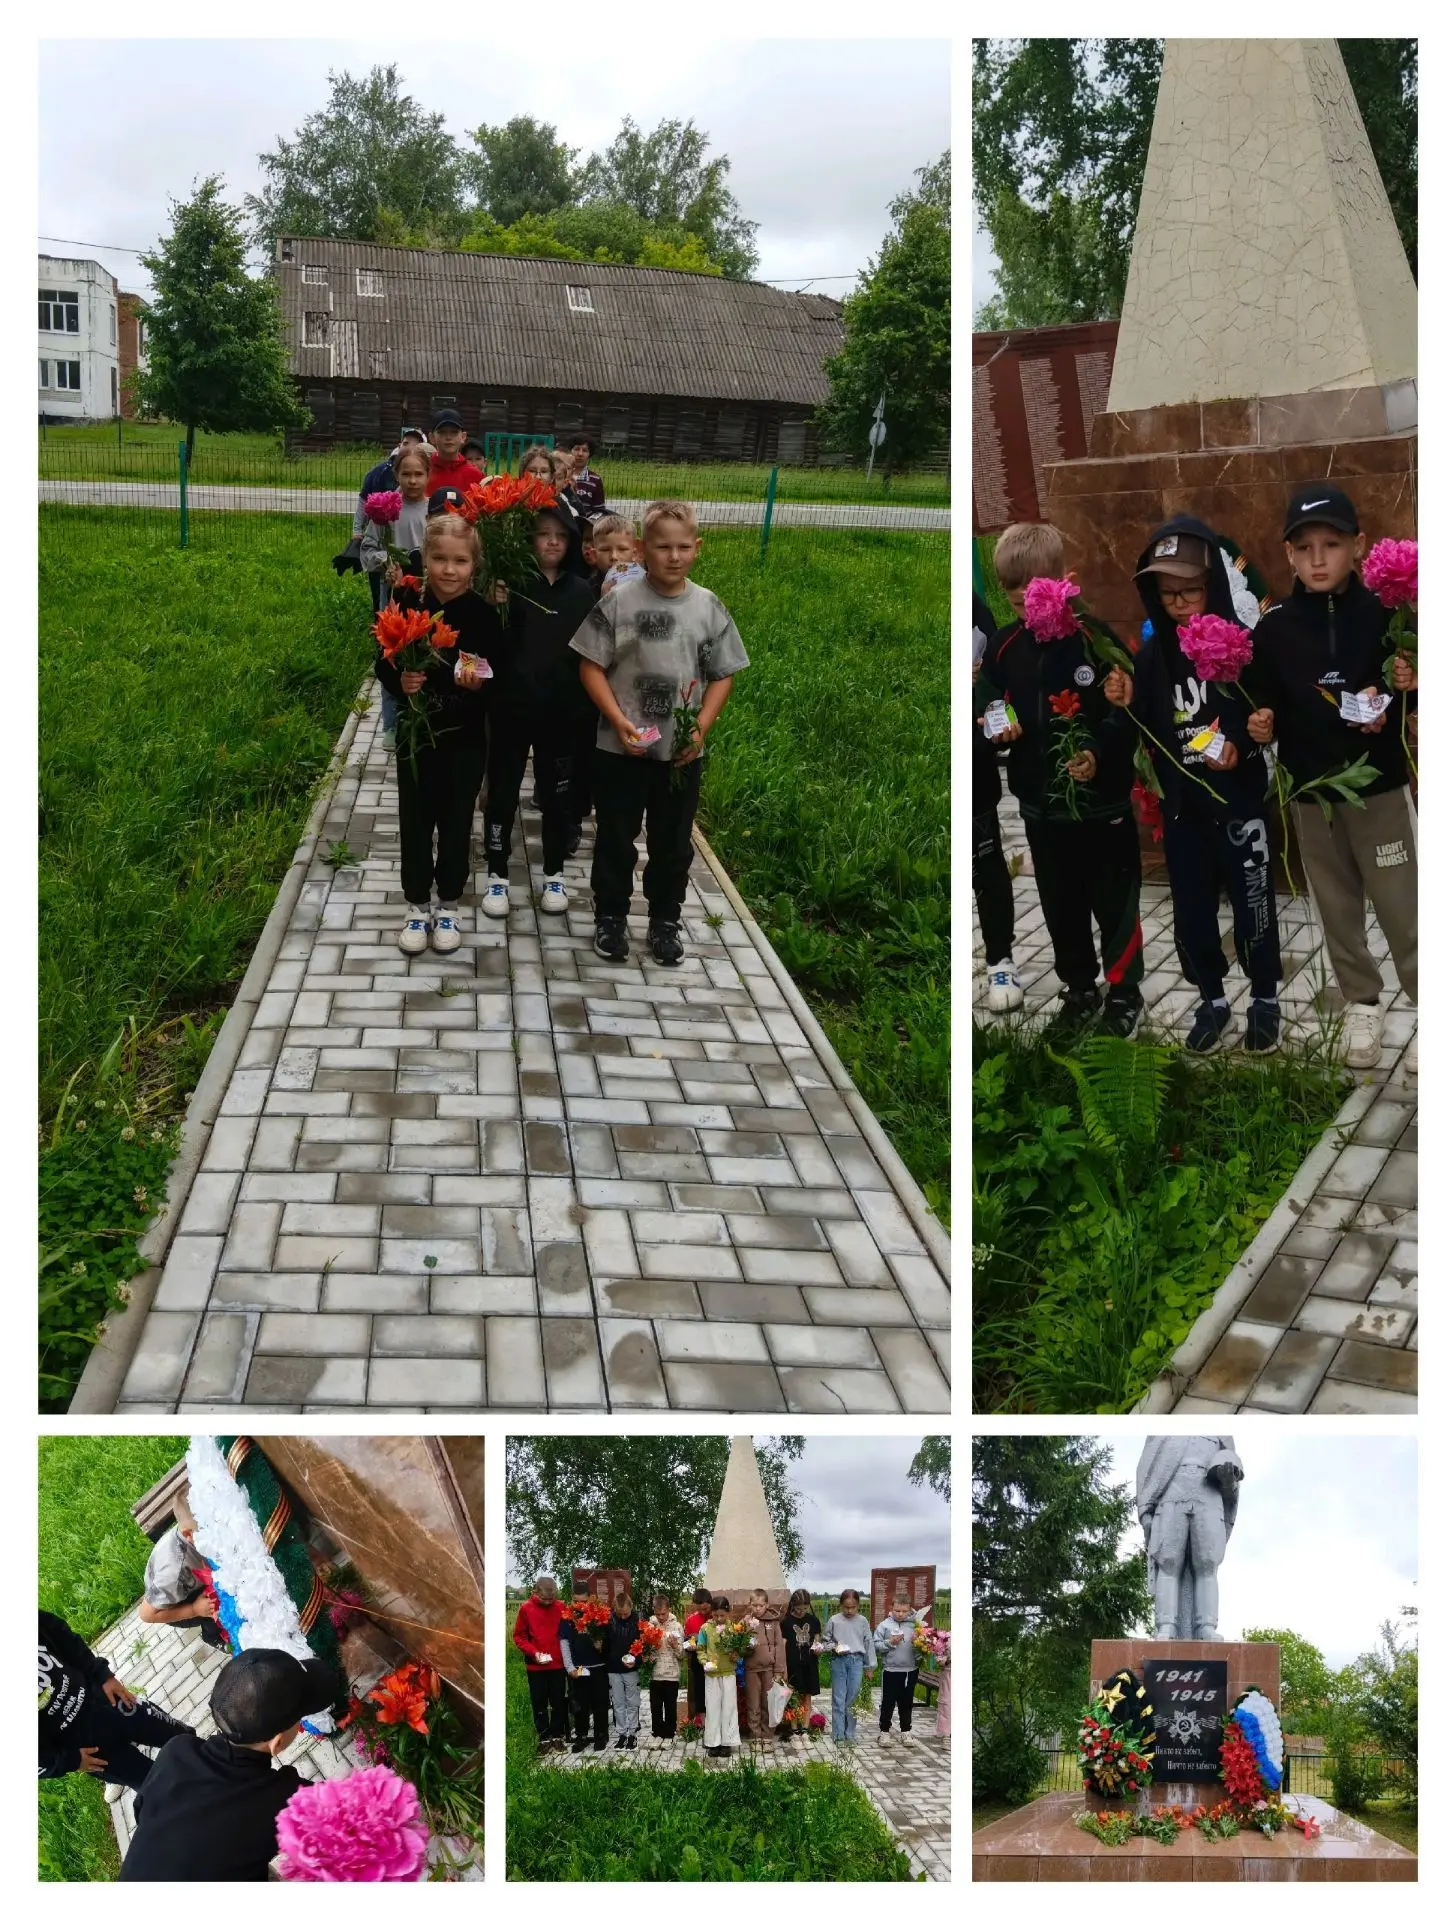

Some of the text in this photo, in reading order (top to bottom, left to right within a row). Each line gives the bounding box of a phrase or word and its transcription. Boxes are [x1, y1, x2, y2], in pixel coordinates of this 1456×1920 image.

[1376, 840, 1404, 857] LIGHT
[1376, 850, 1409, 867] BURST
[1155, 1670, 1204, 1683] 1941
[1170, 1689, 1217, 1702] 1945
